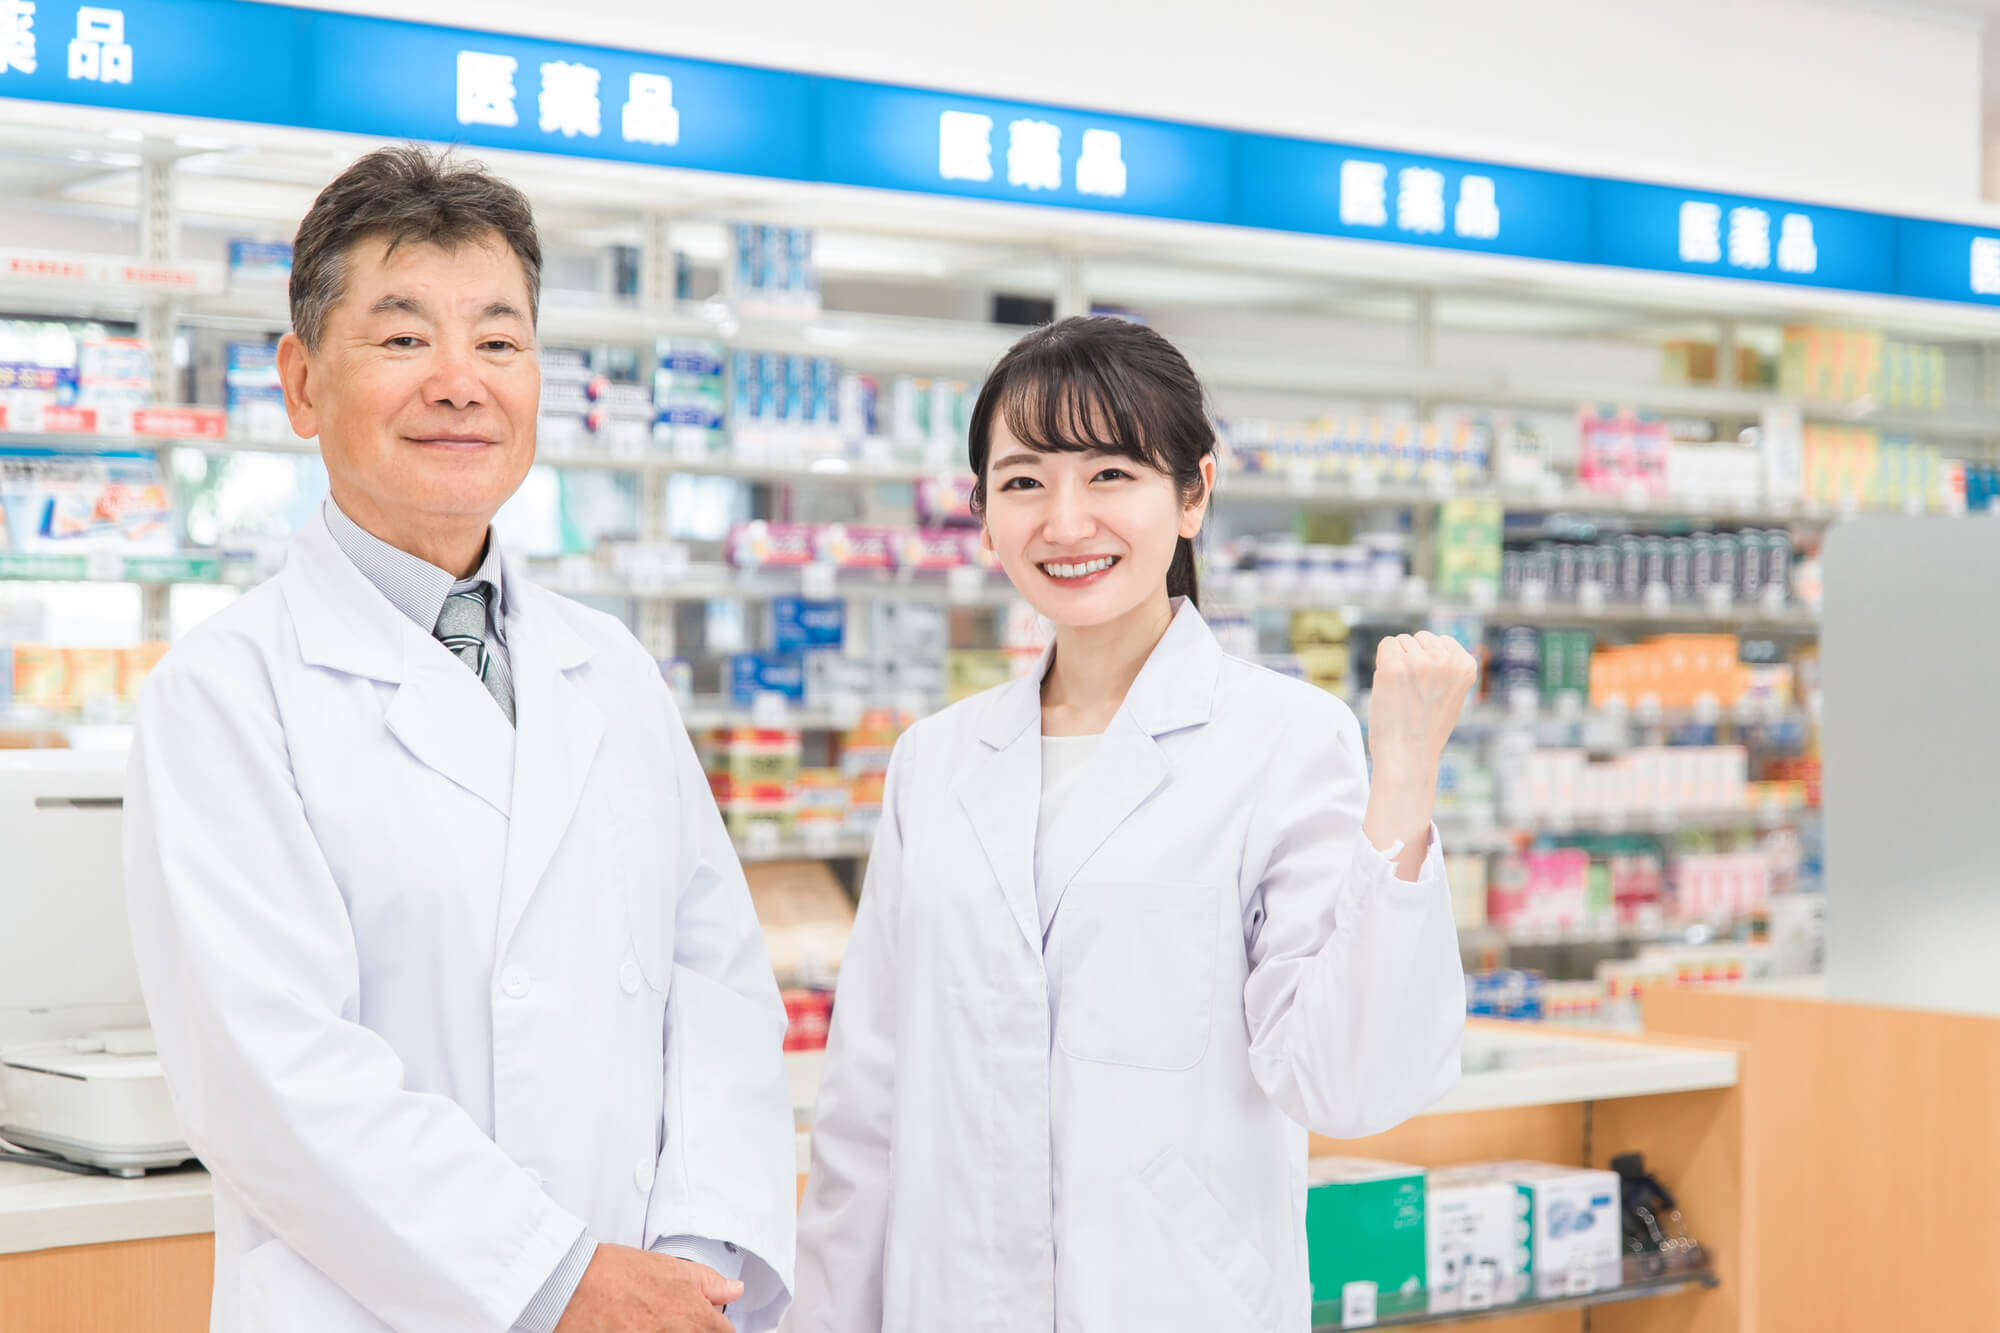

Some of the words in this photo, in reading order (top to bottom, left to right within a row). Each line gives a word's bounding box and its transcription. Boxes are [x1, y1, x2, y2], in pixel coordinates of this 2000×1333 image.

[457, 51, 679, 146] 医薬品
[939, 110, 1126, 196] 医薬品
[1341, 161, 1499, 237] 医薬品
[1680, 202, 1816, 272] 医薬品
